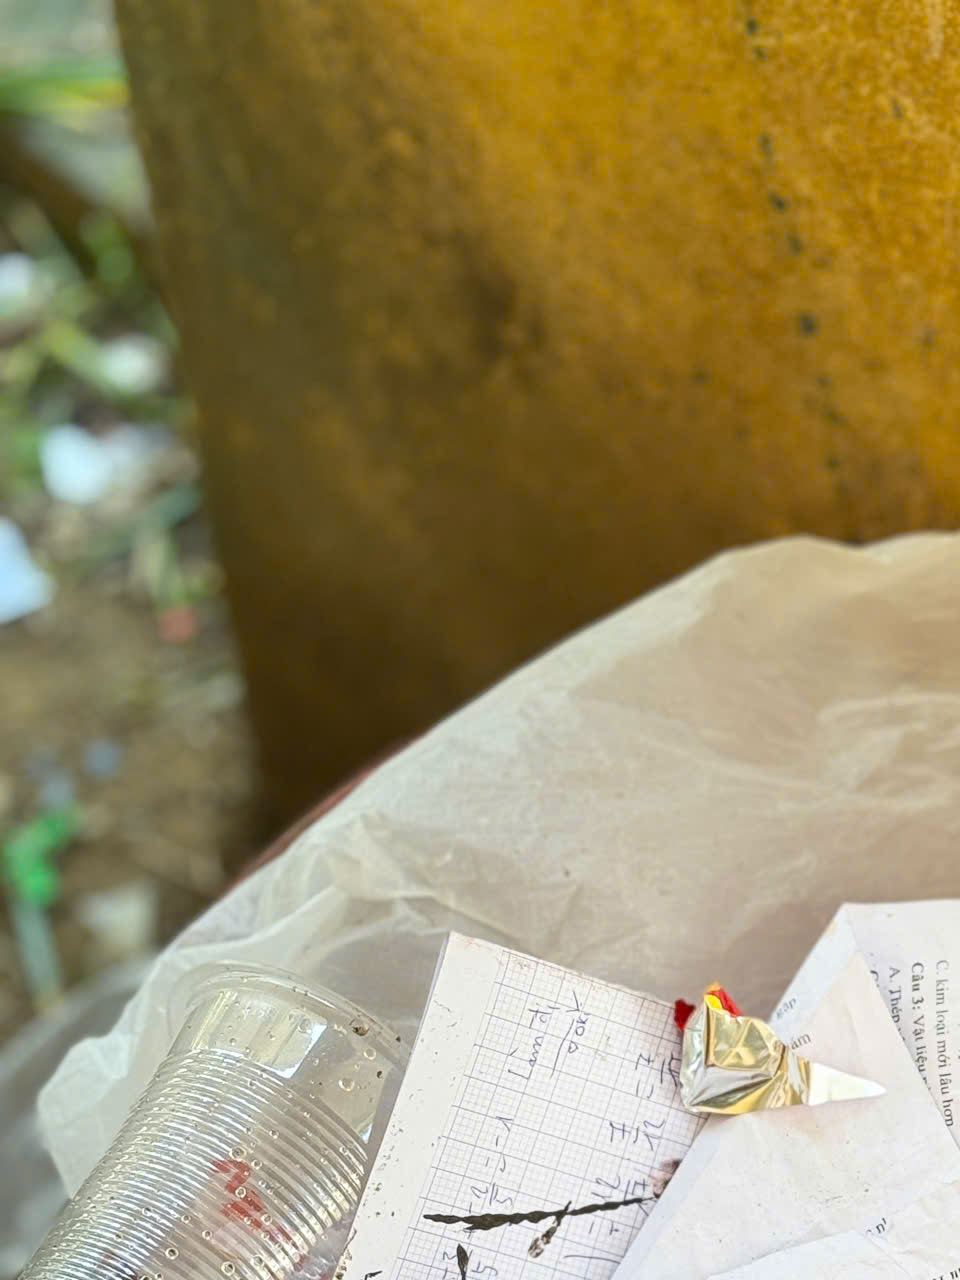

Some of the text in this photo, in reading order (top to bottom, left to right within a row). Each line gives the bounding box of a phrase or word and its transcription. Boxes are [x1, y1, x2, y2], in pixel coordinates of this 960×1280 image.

[912, 962, 927, 1073] Câu Vật liệu
[936, 979, 953, 1126] kim loại mới lâu hơn
